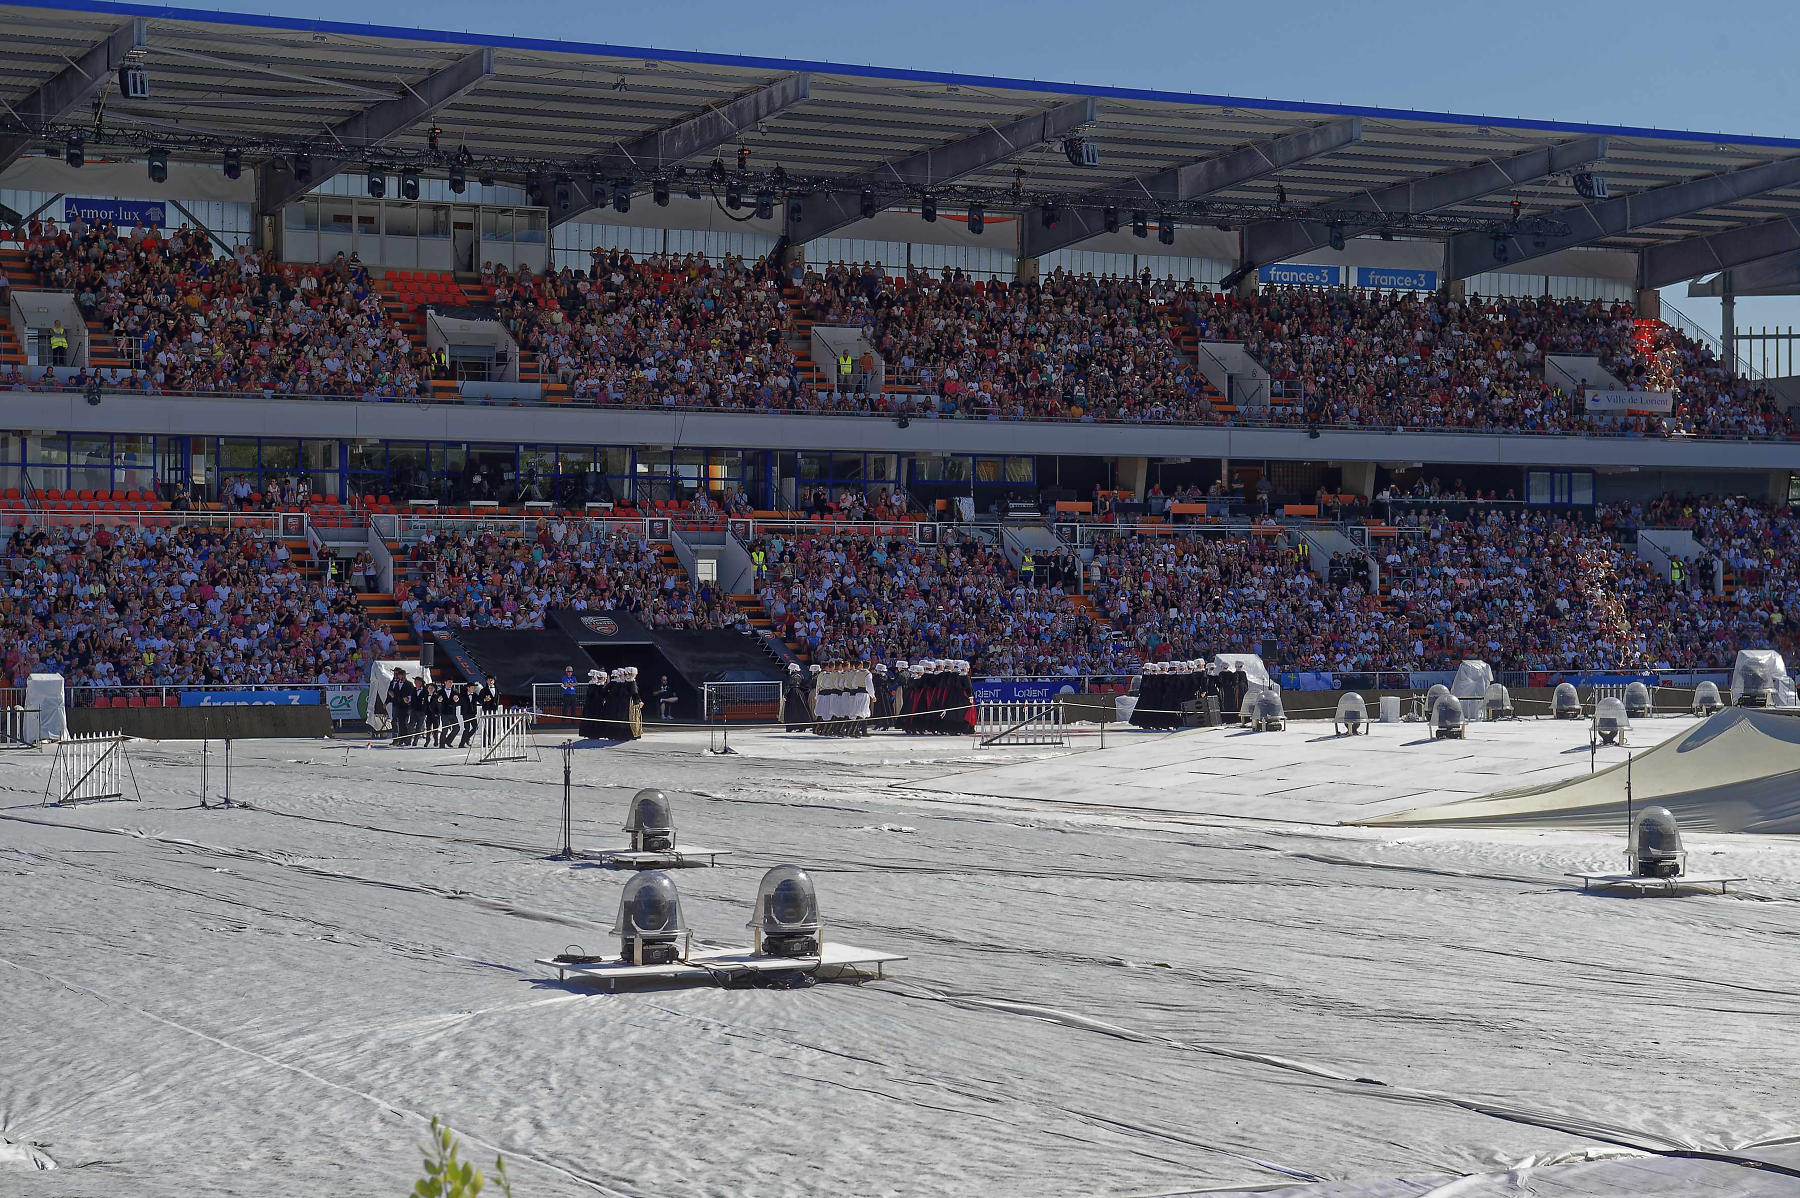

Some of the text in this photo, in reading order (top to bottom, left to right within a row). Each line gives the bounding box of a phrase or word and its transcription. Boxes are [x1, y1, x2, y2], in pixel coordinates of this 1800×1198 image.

[1606, 393, 1668, 406] Ville de Lorient
